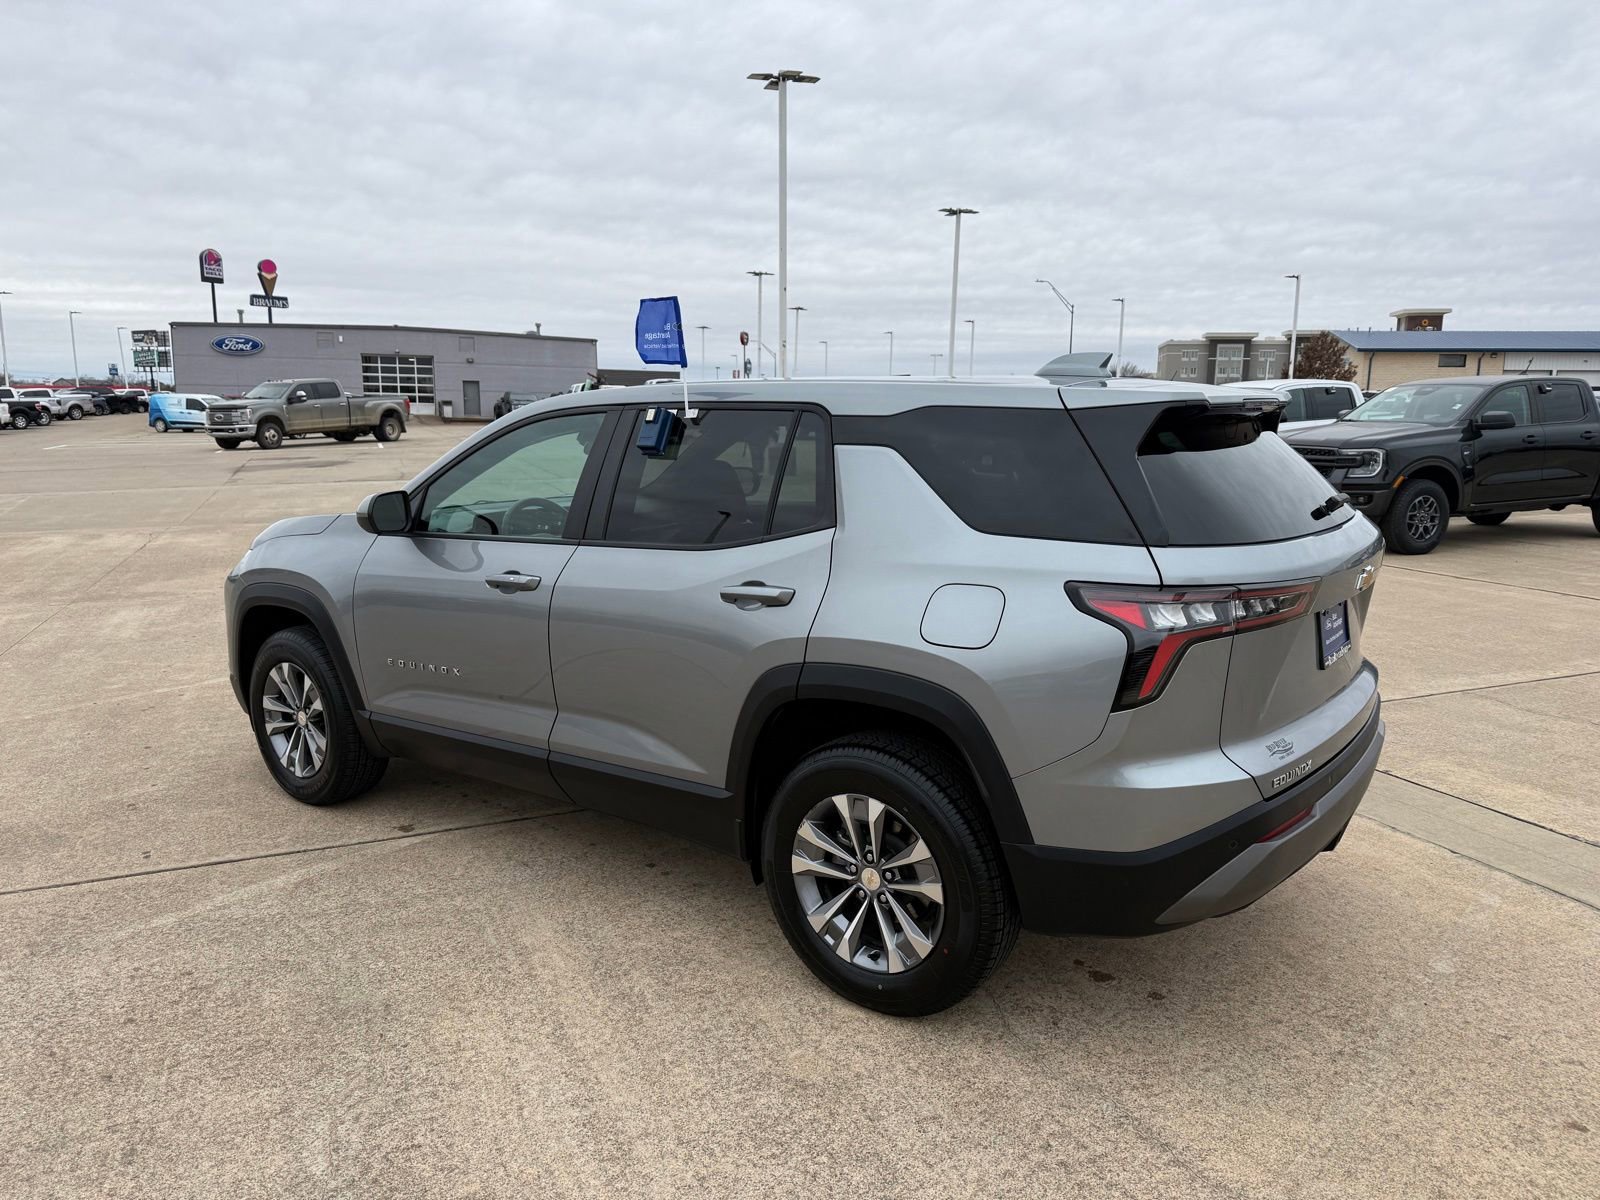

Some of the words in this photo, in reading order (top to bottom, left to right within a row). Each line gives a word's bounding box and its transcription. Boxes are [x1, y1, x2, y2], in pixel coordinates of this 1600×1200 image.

[253, 297, 289, 308] BRAUM'S
[222, 337, 253, 351] Ford
[387, 658, 460, 676] EQUINOX
[1272, 759, 1312, 789] EQUINOX
